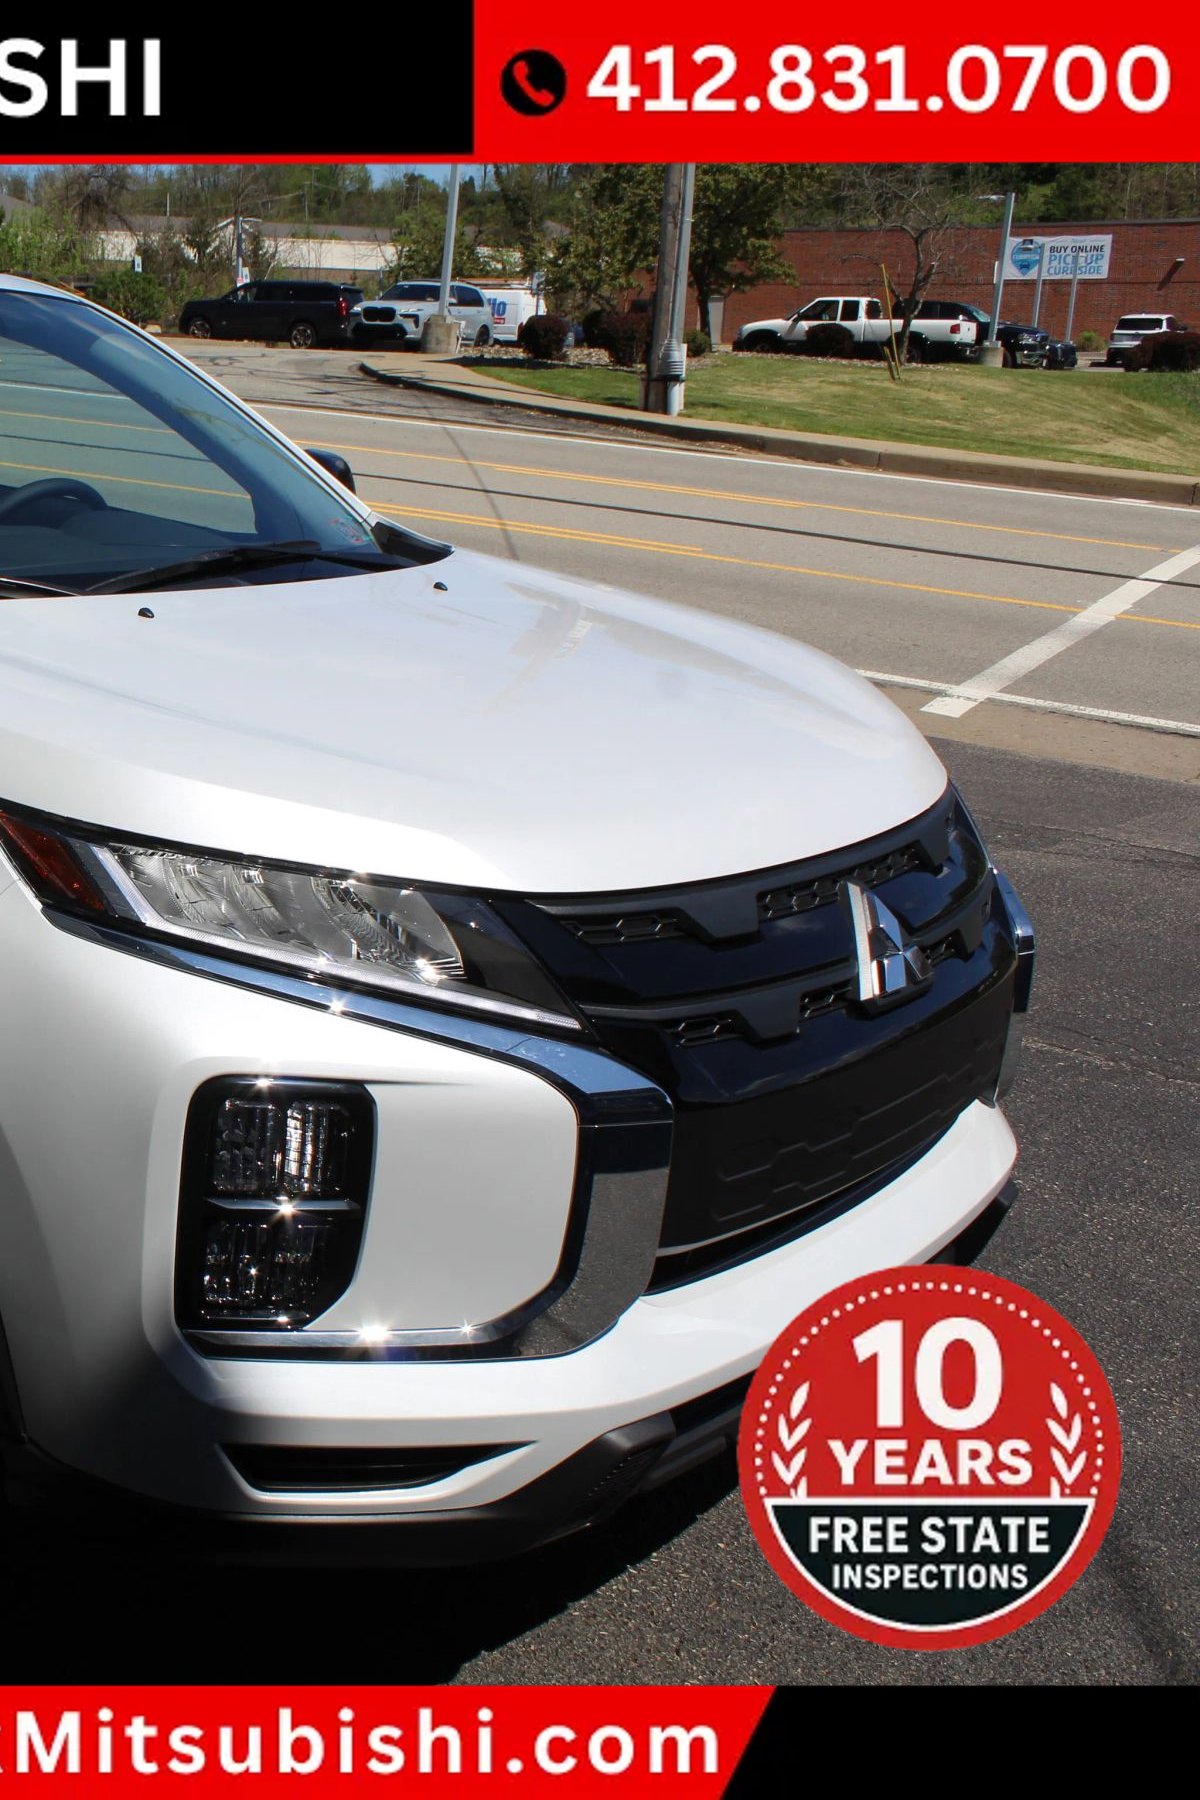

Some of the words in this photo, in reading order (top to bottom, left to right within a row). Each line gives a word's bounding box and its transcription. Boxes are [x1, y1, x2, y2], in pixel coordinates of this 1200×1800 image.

[1049, 245, 1068, 254] BUY
[1071, 244, 1105, 254] ONLINE
[1084, 253, 1105, 266] UP
